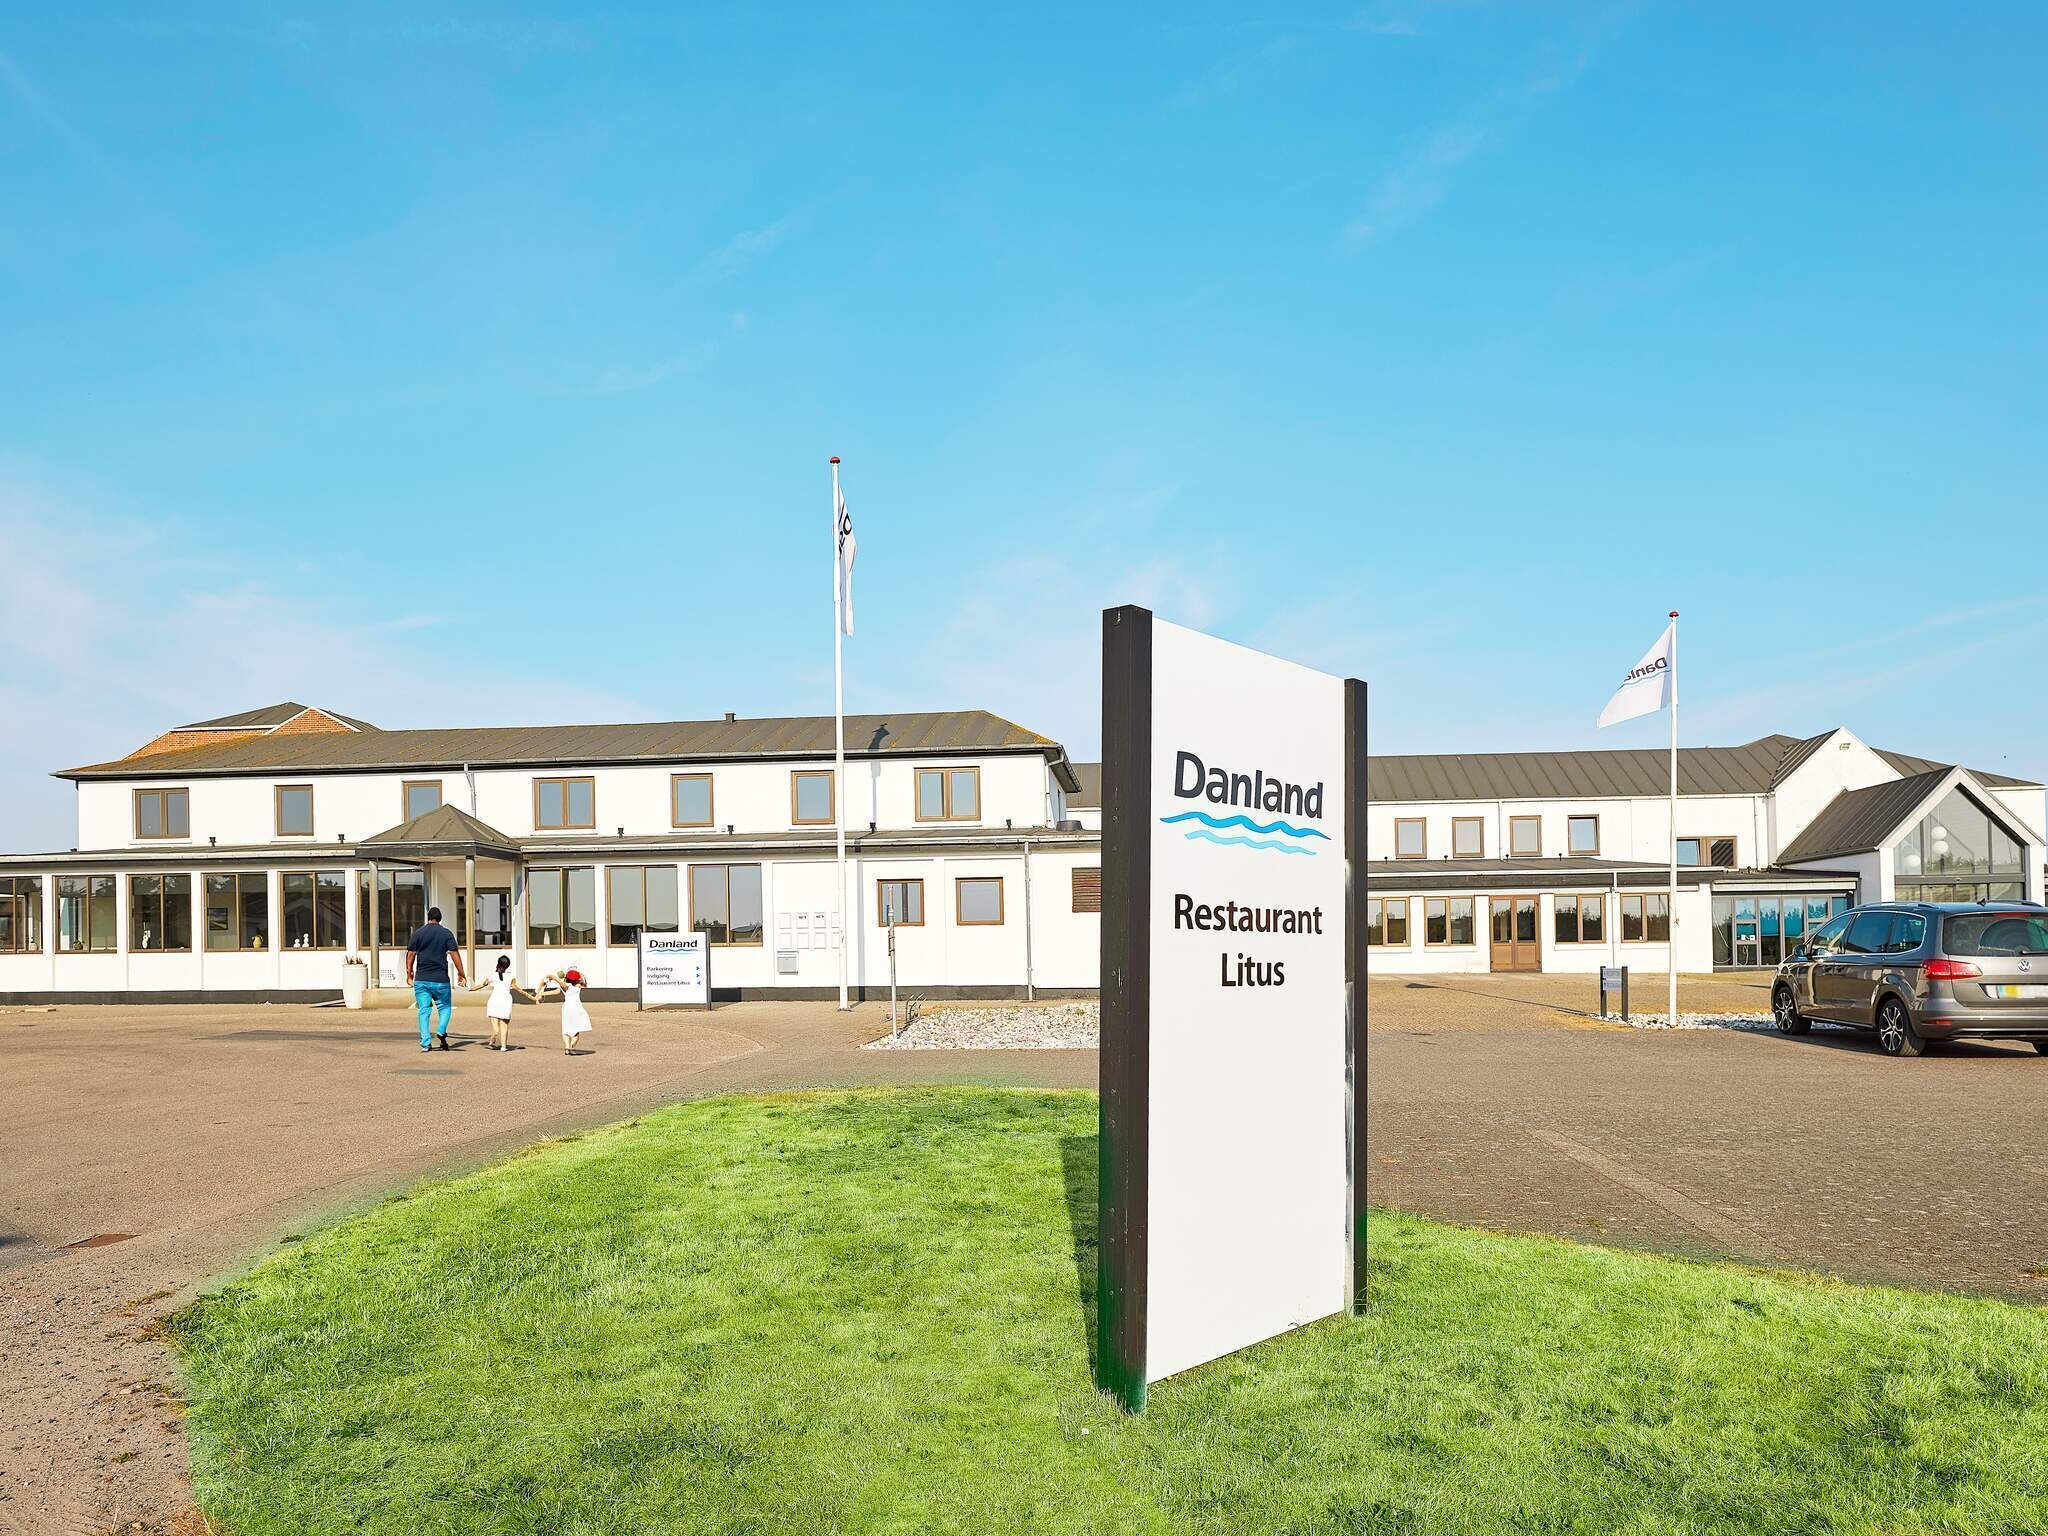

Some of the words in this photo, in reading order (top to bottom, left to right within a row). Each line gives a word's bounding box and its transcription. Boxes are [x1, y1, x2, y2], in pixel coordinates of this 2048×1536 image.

[1174, 750, 1323, 819] Danland
[1174, 893, 1323, 935] Restaurant
[649, 939, 698, 948] Danland
[1221, 952, 1285, 987] Litus
